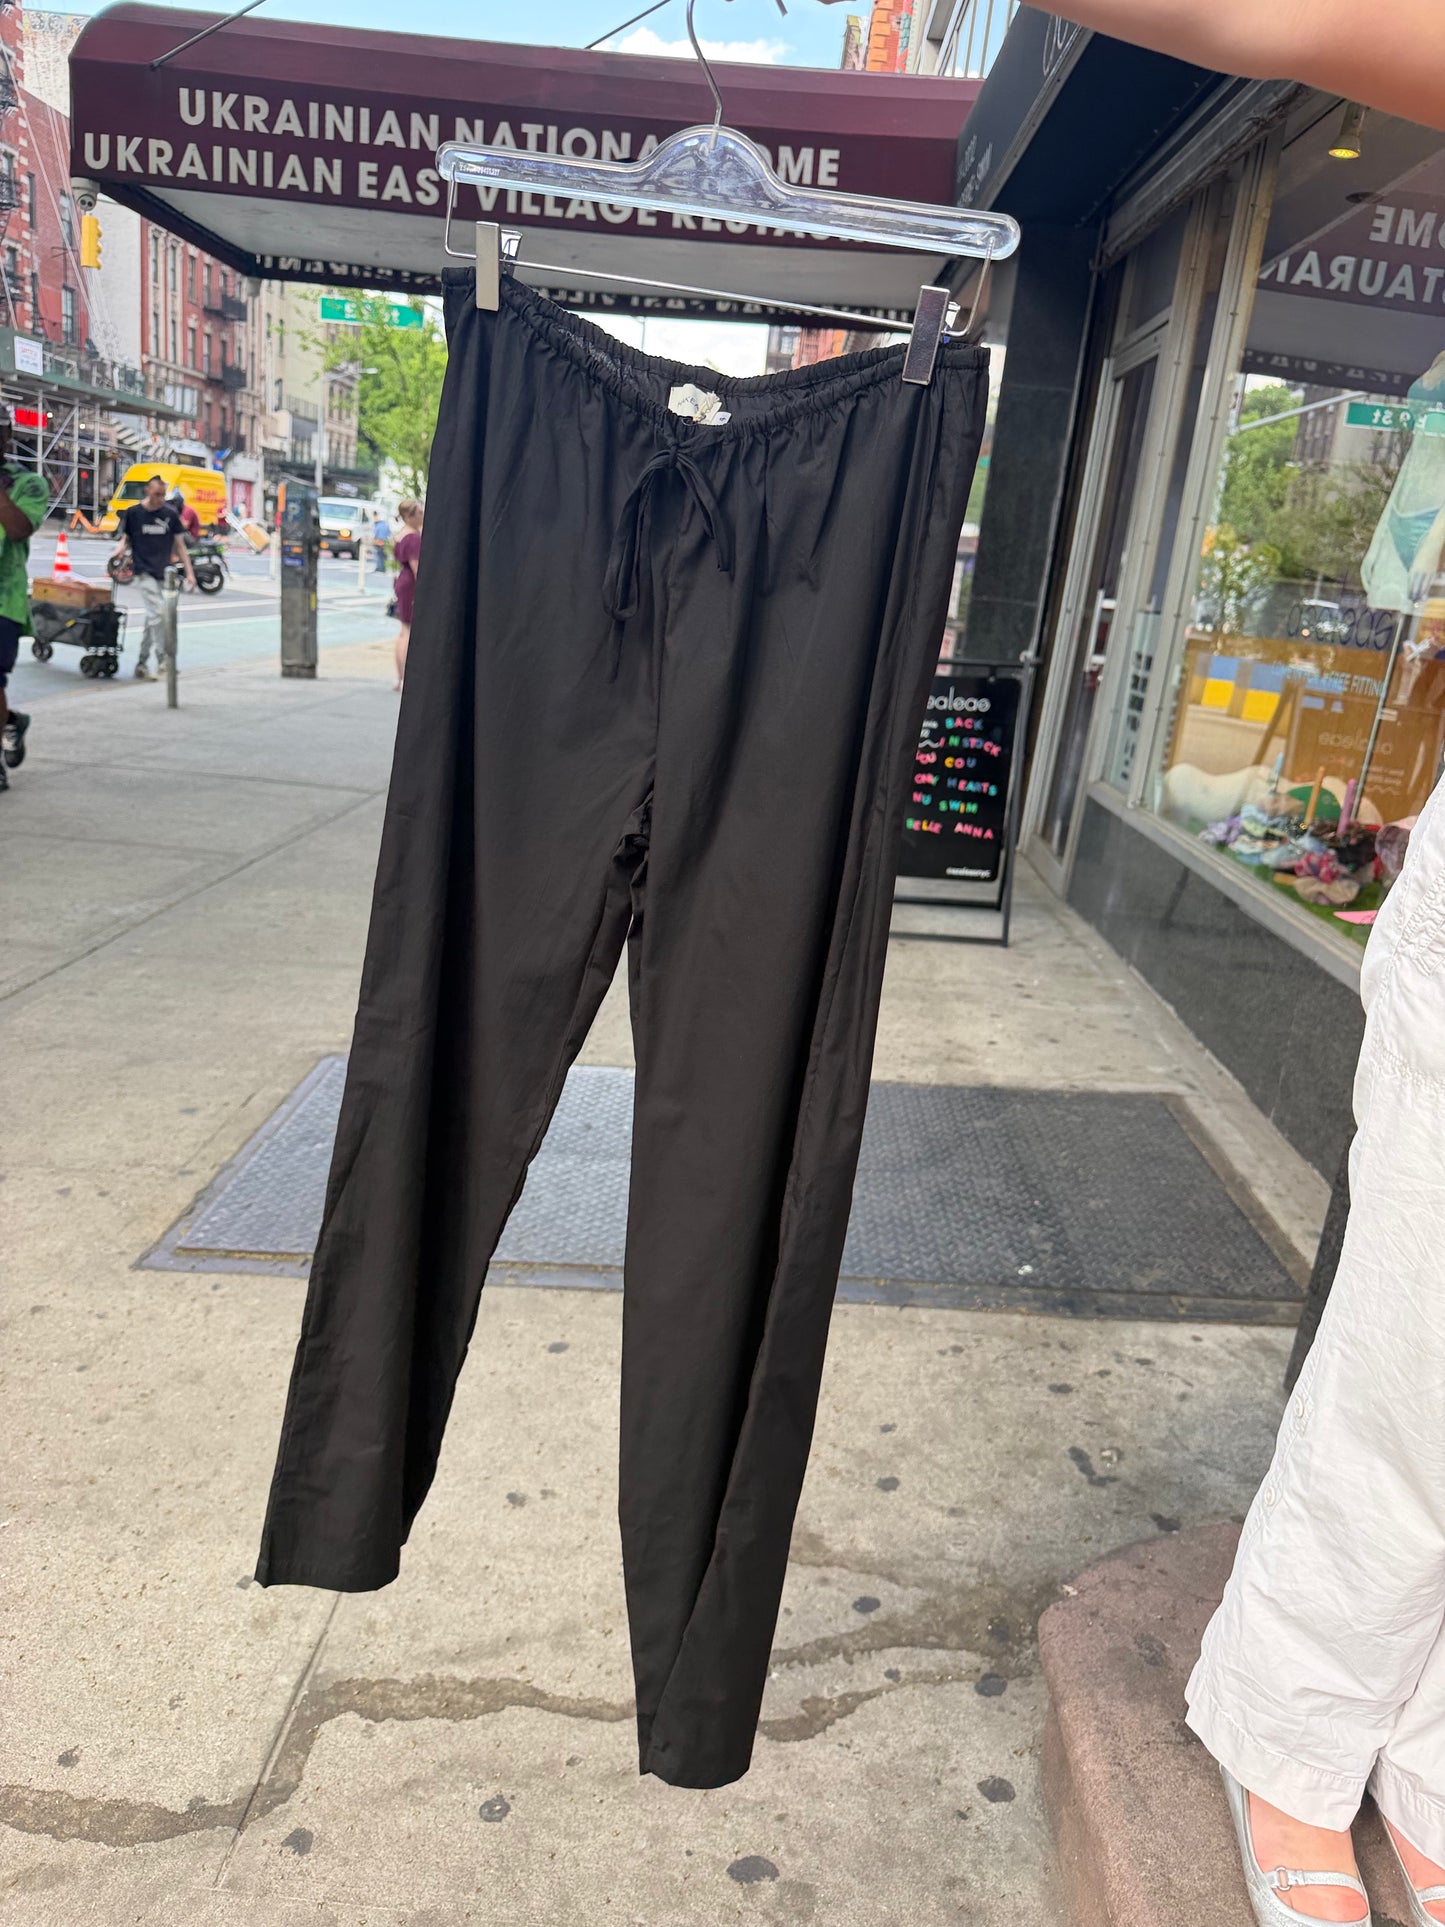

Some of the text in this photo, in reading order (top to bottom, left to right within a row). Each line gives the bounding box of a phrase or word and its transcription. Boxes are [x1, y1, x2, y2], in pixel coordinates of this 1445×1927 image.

[179, 87, 439, 151] UKRAINIAN
[455, 117, 662, 162] NATIONA
[84, 132, 343, 196] UKRAINIAN
[945, 717, 983, 731] BACK
[962, 737, 1001, 757] STOCK
[944, 756, 977, 769] COU
[939, 799, 979, 815] SWIM
[954, 822, 994, 839] ANNA
